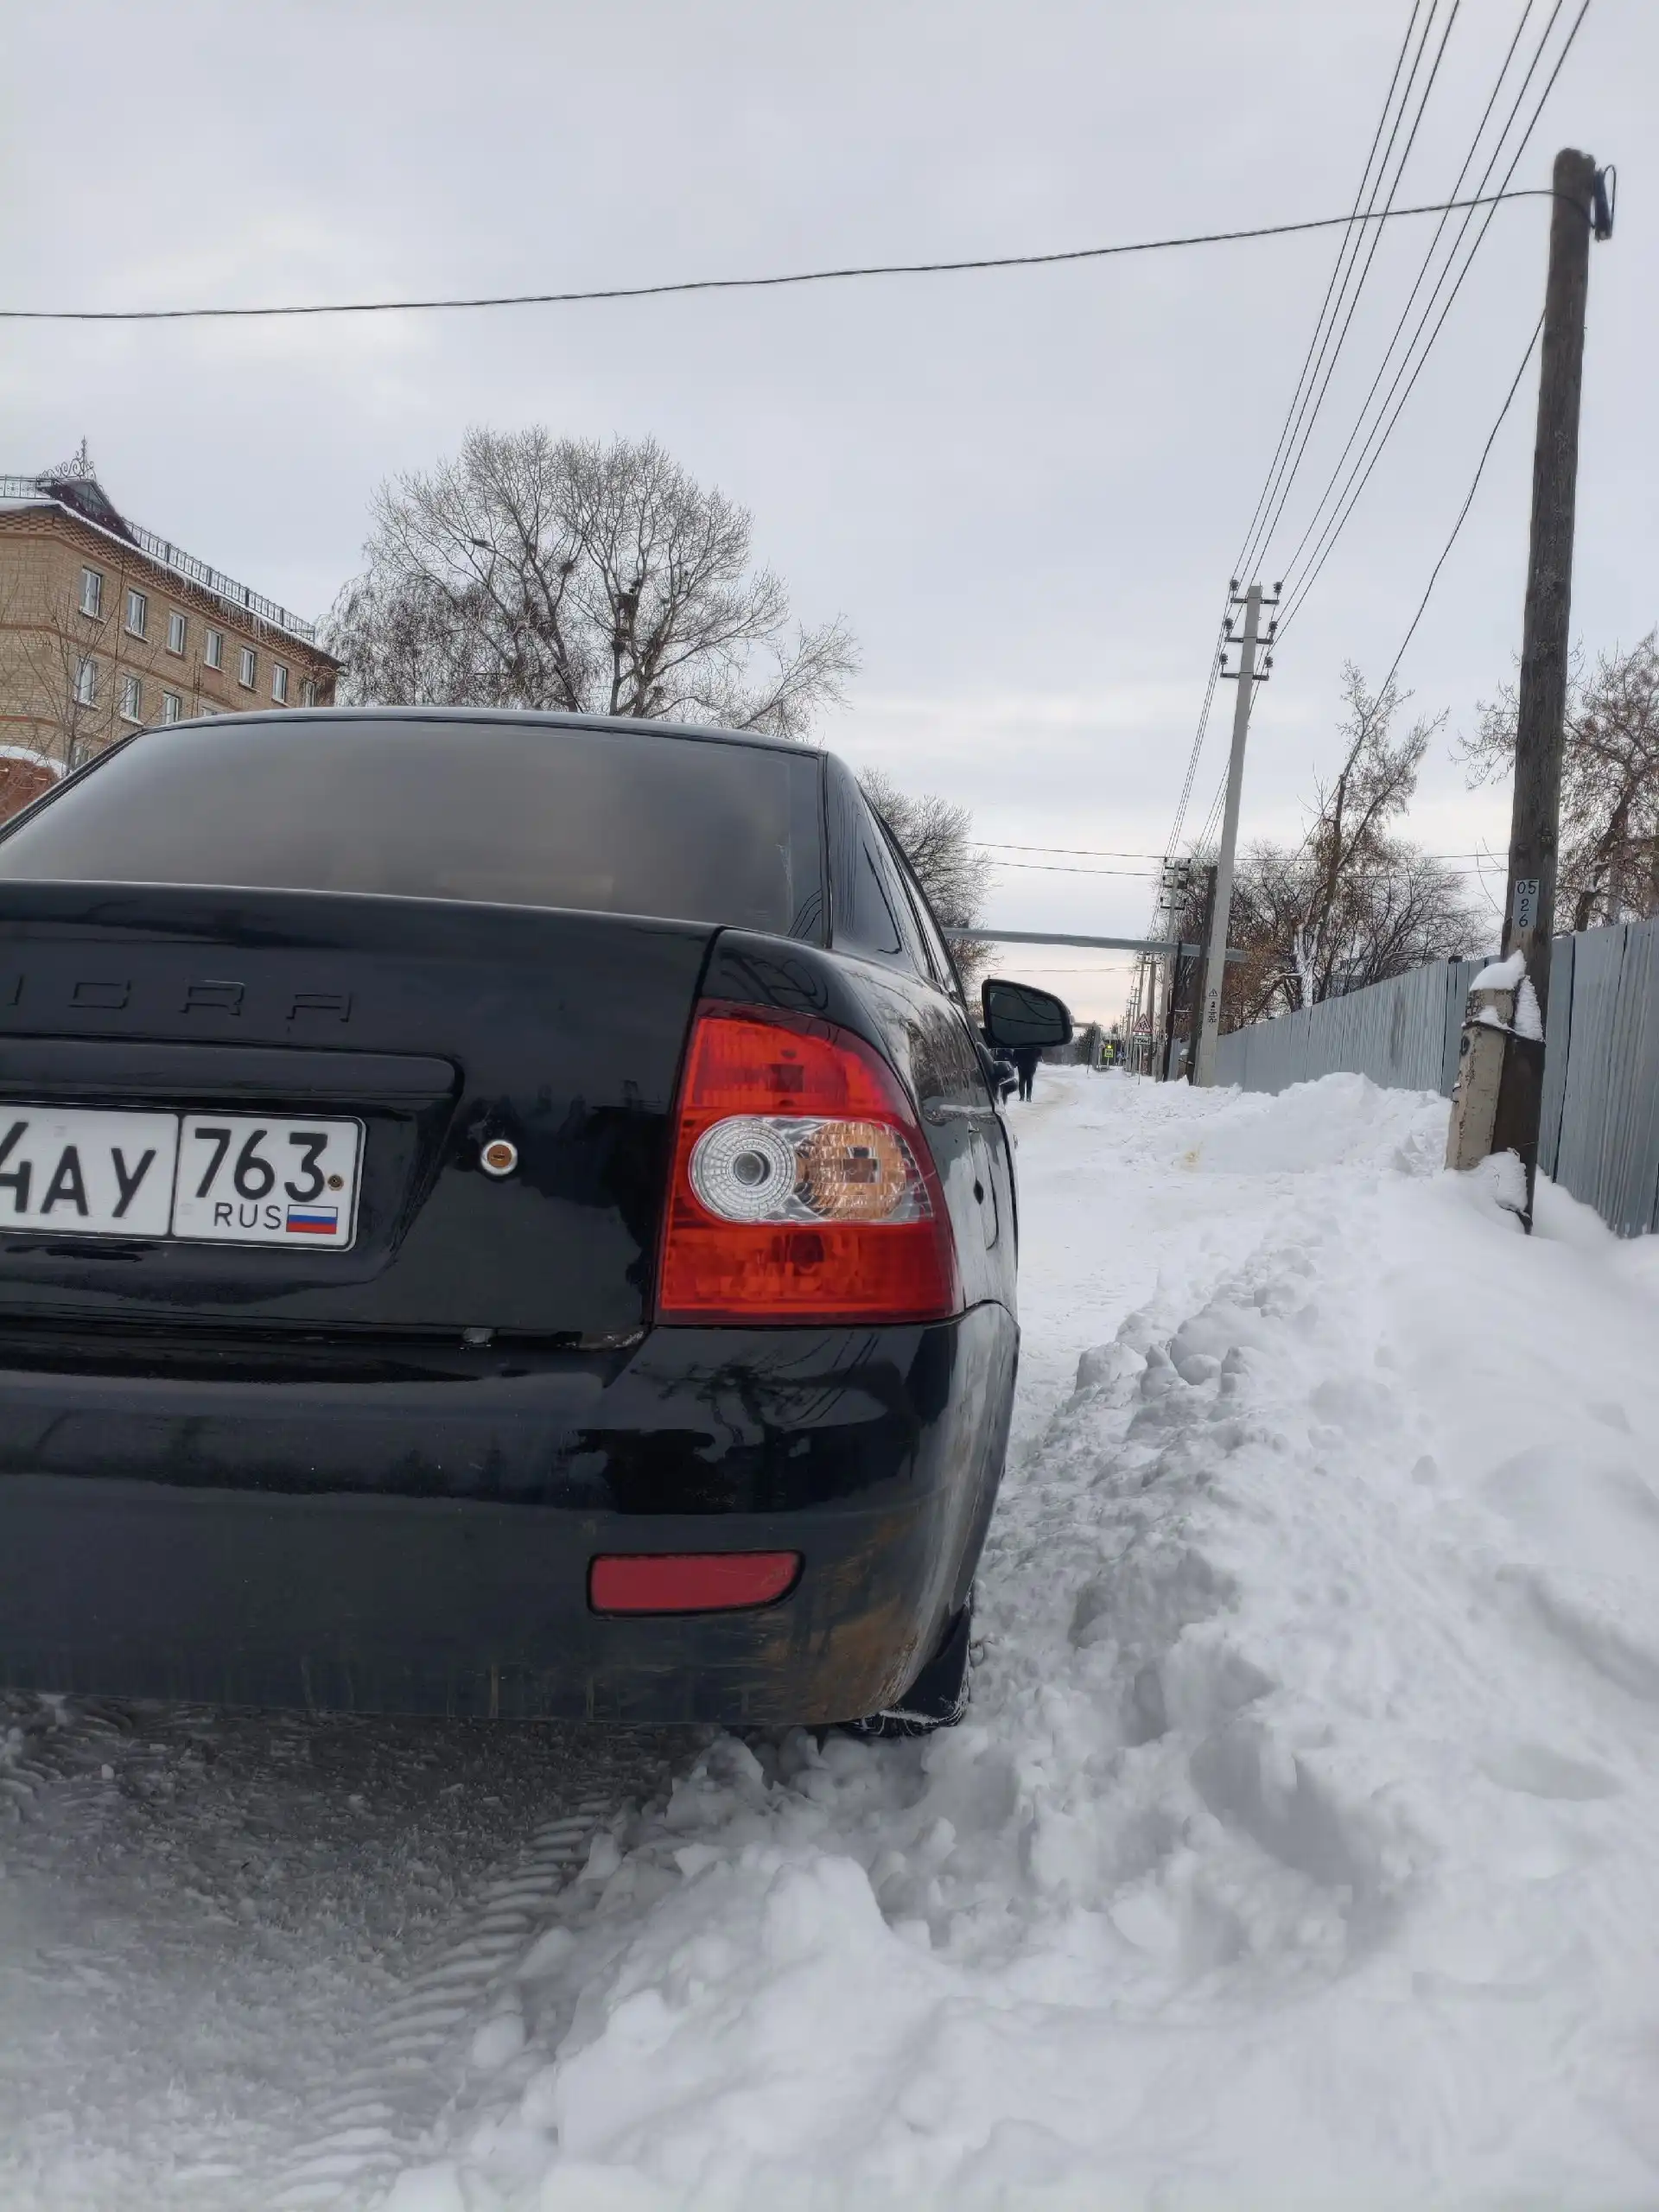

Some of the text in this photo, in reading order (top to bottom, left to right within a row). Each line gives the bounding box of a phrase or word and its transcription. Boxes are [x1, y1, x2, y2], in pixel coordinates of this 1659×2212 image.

[1517, 880, 1538, 894] 05
[1521, 899, 1529, 912] 2
[1519, 914, 1528, 927] 6
[194, 1128, 328, 1203] 763
[214, 1202, 281, 1230] RUS
